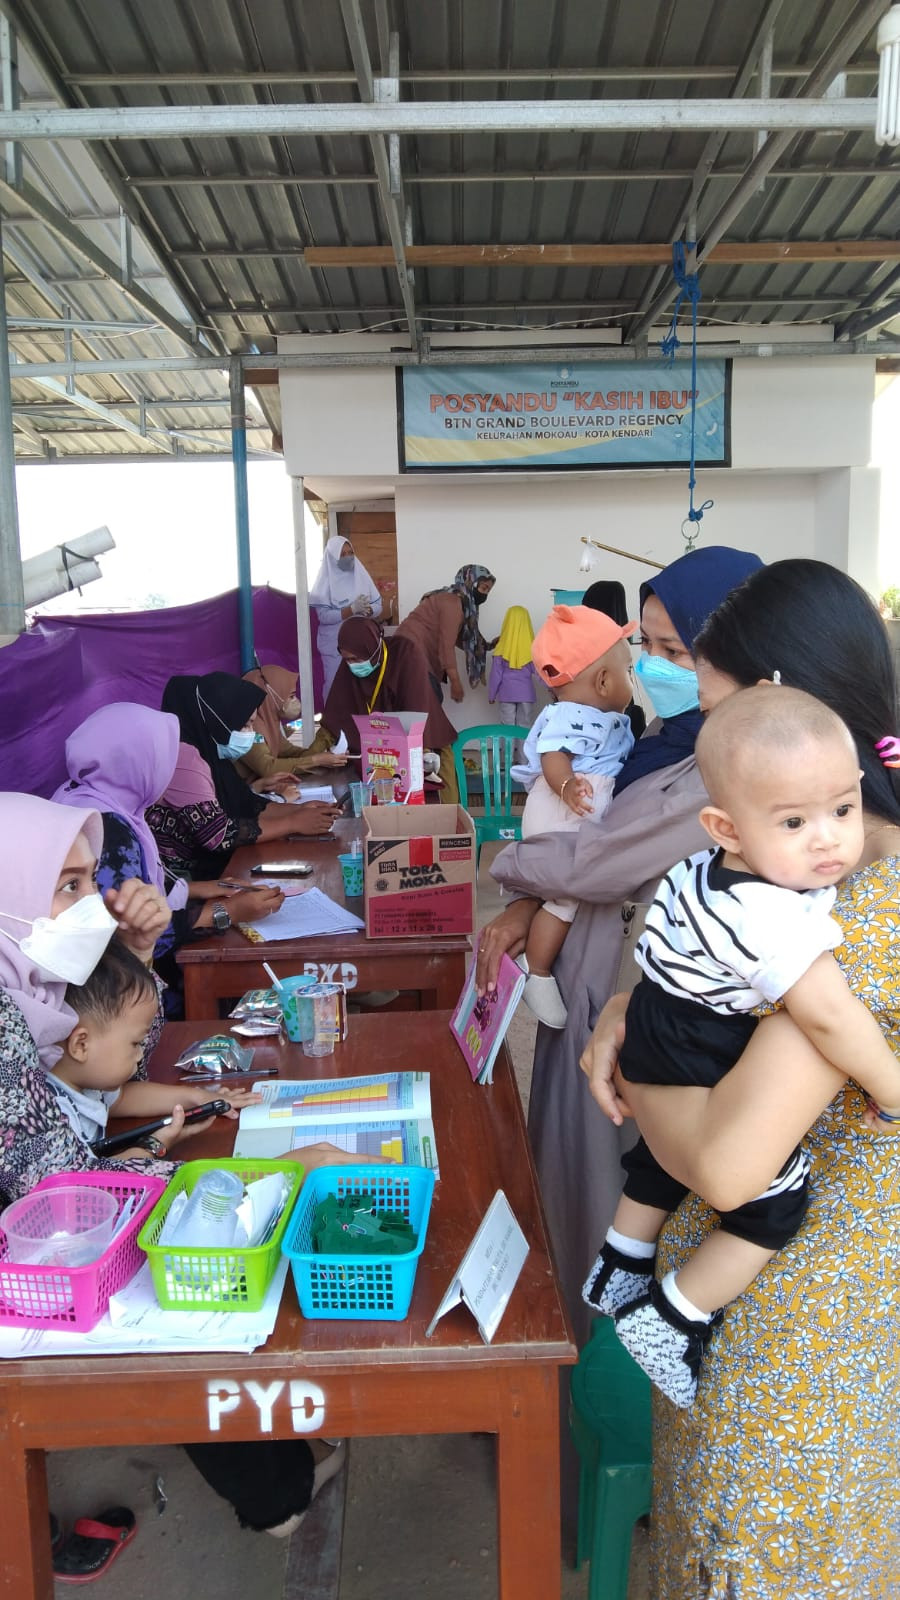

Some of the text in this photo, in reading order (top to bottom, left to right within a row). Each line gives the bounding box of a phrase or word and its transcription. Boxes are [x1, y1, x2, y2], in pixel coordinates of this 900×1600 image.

[429, 392, 557, 413] POSYANDU
[562, 390, 643, 411] "KASIH
[444, 413, 684, 429] BTN GRAND BOULEVARD REGENCY
[476, 431, 533, 440] KELURAHAN
[535, 430, 578, 440] MOKOAU
[585, 430, 610, 438] KOTA
[612, 428, 653, 438] KENDARI
[368, 753, 398, 767] BALITA
[399, 863, 442, 877] TORA
[399, 873, 448, 890] MOKA
[208, 1380, 325, 1433] PYD
